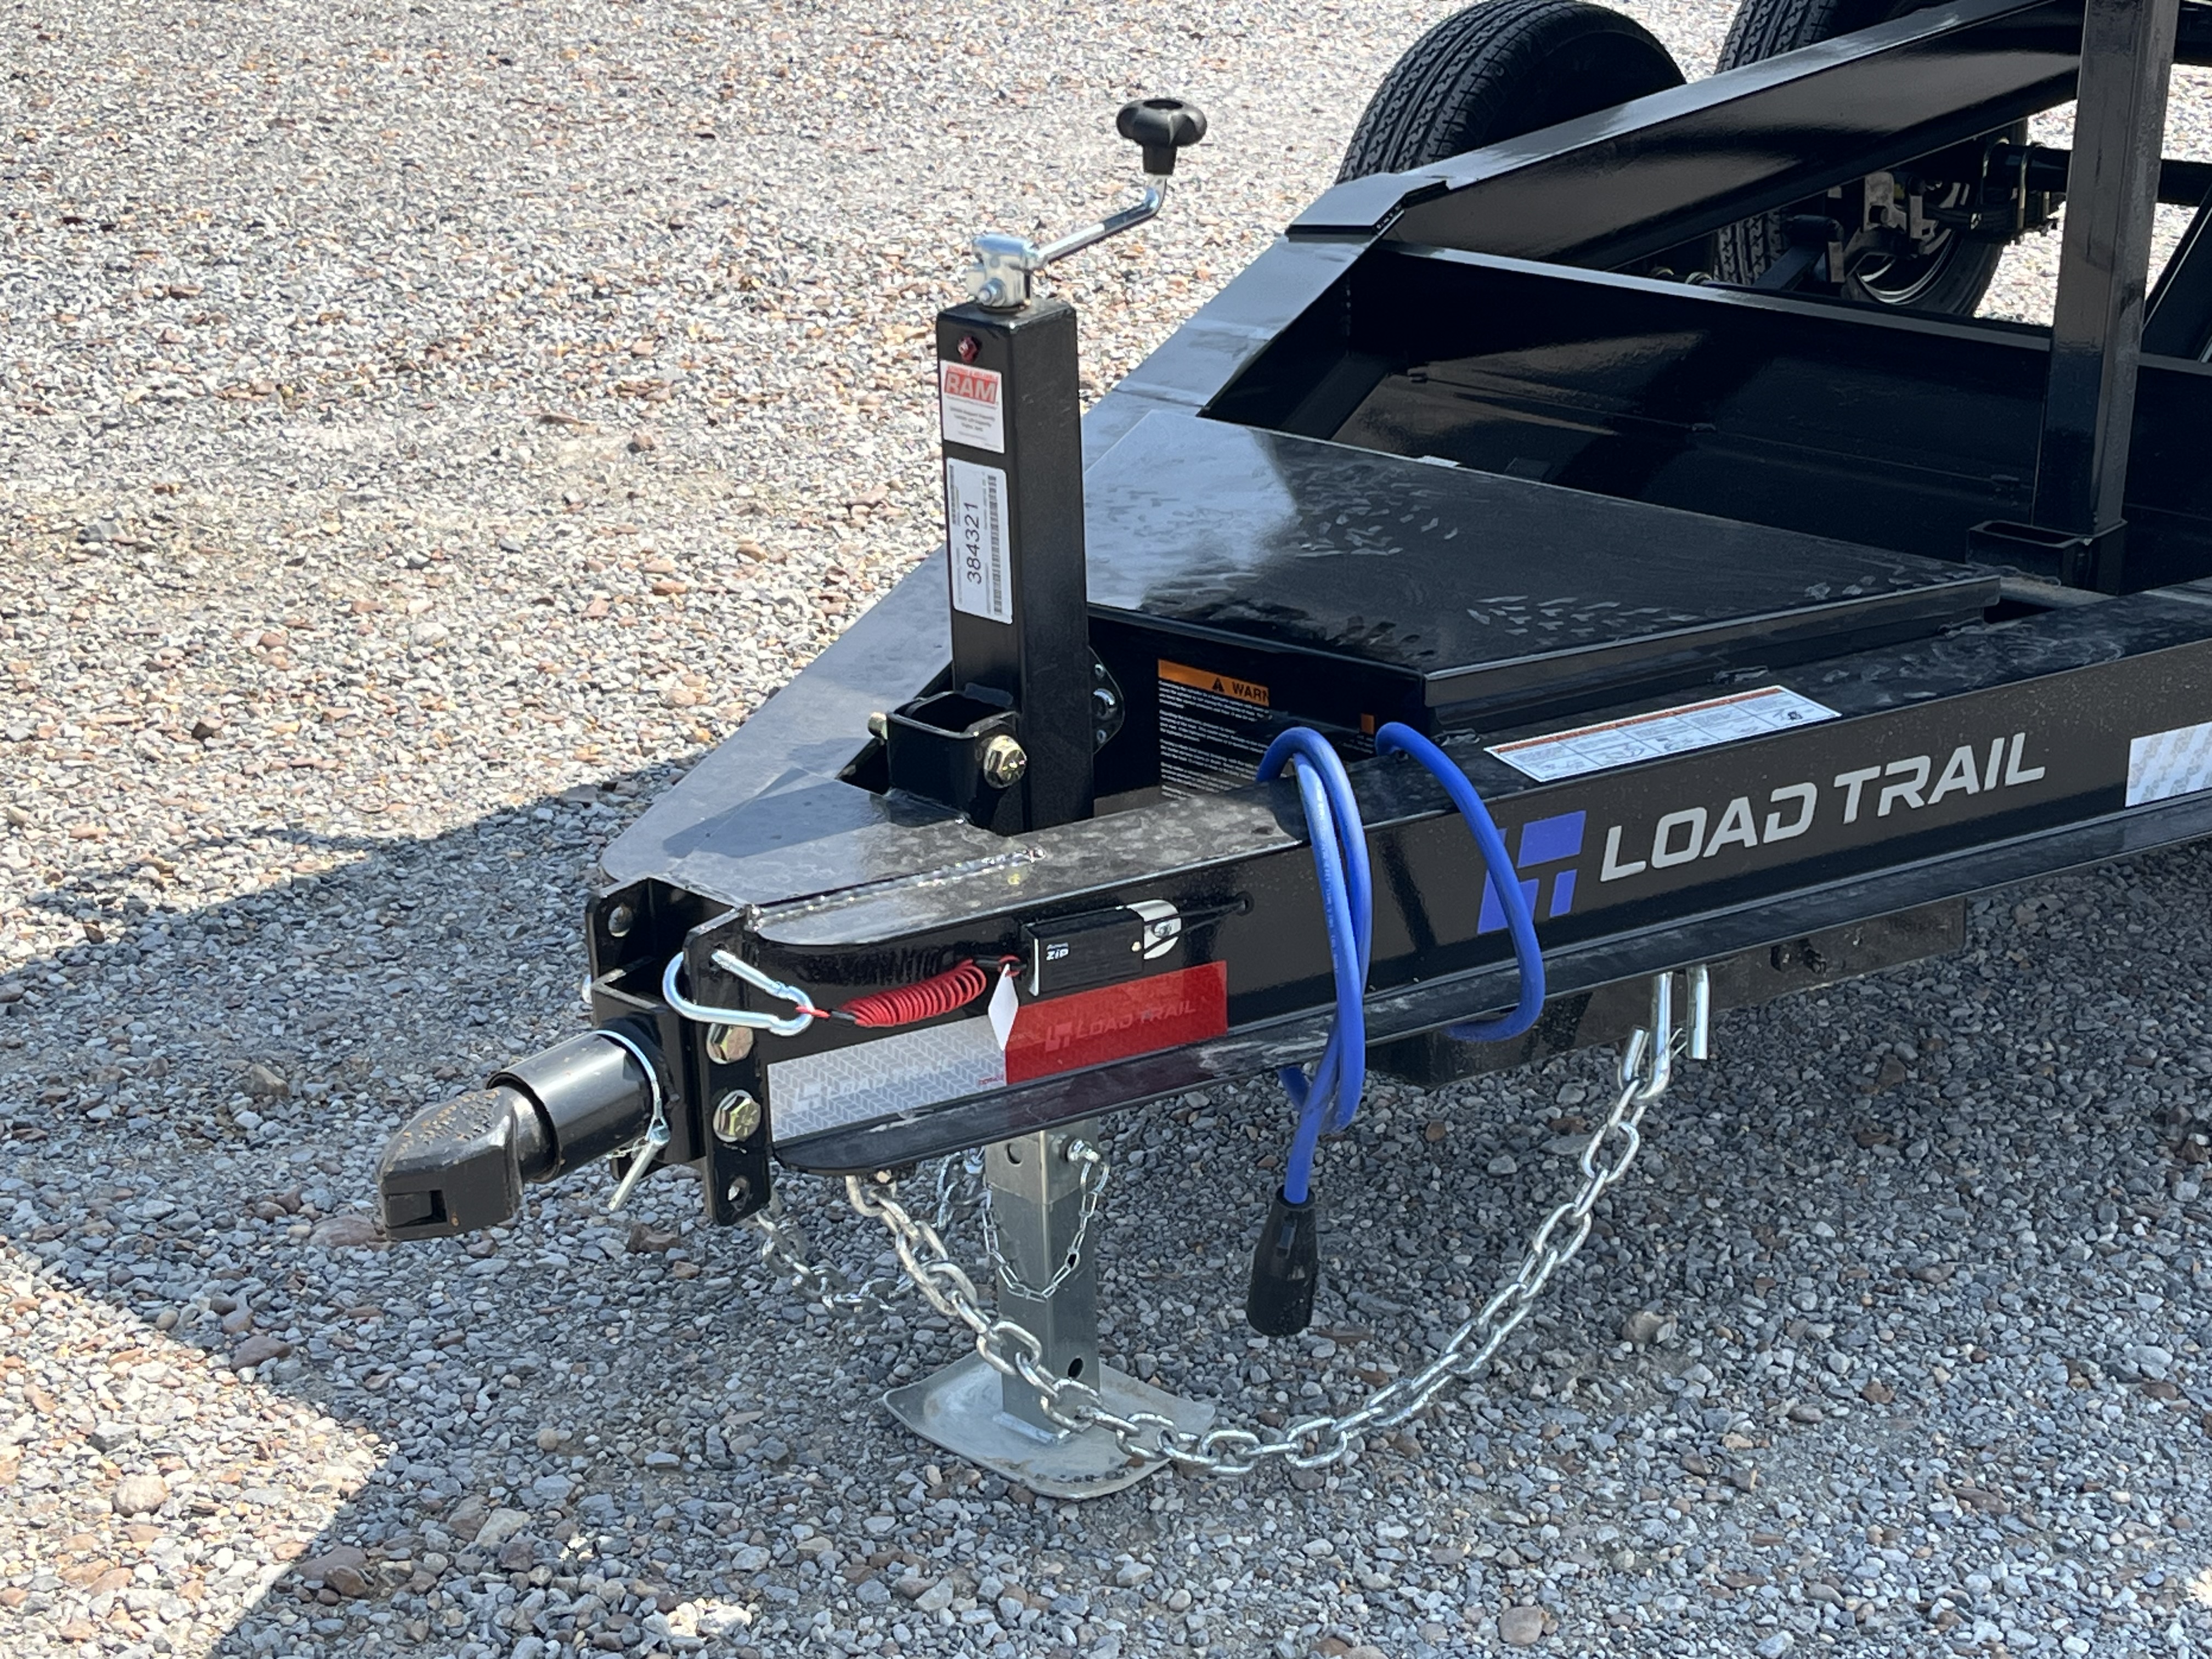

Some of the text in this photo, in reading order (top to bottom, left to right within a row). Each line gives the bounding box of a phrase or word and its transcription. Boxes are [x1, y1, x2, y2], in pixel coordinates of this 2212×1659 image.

[946, 373, 997, 403] RAM
[963, 502, 982, 585] 384321
[1600, 782, 1818, 882] LOAD
[1833, 732, 2046, 824] TRAIL
[1075, 1015, 1133, 1040] LOAD
